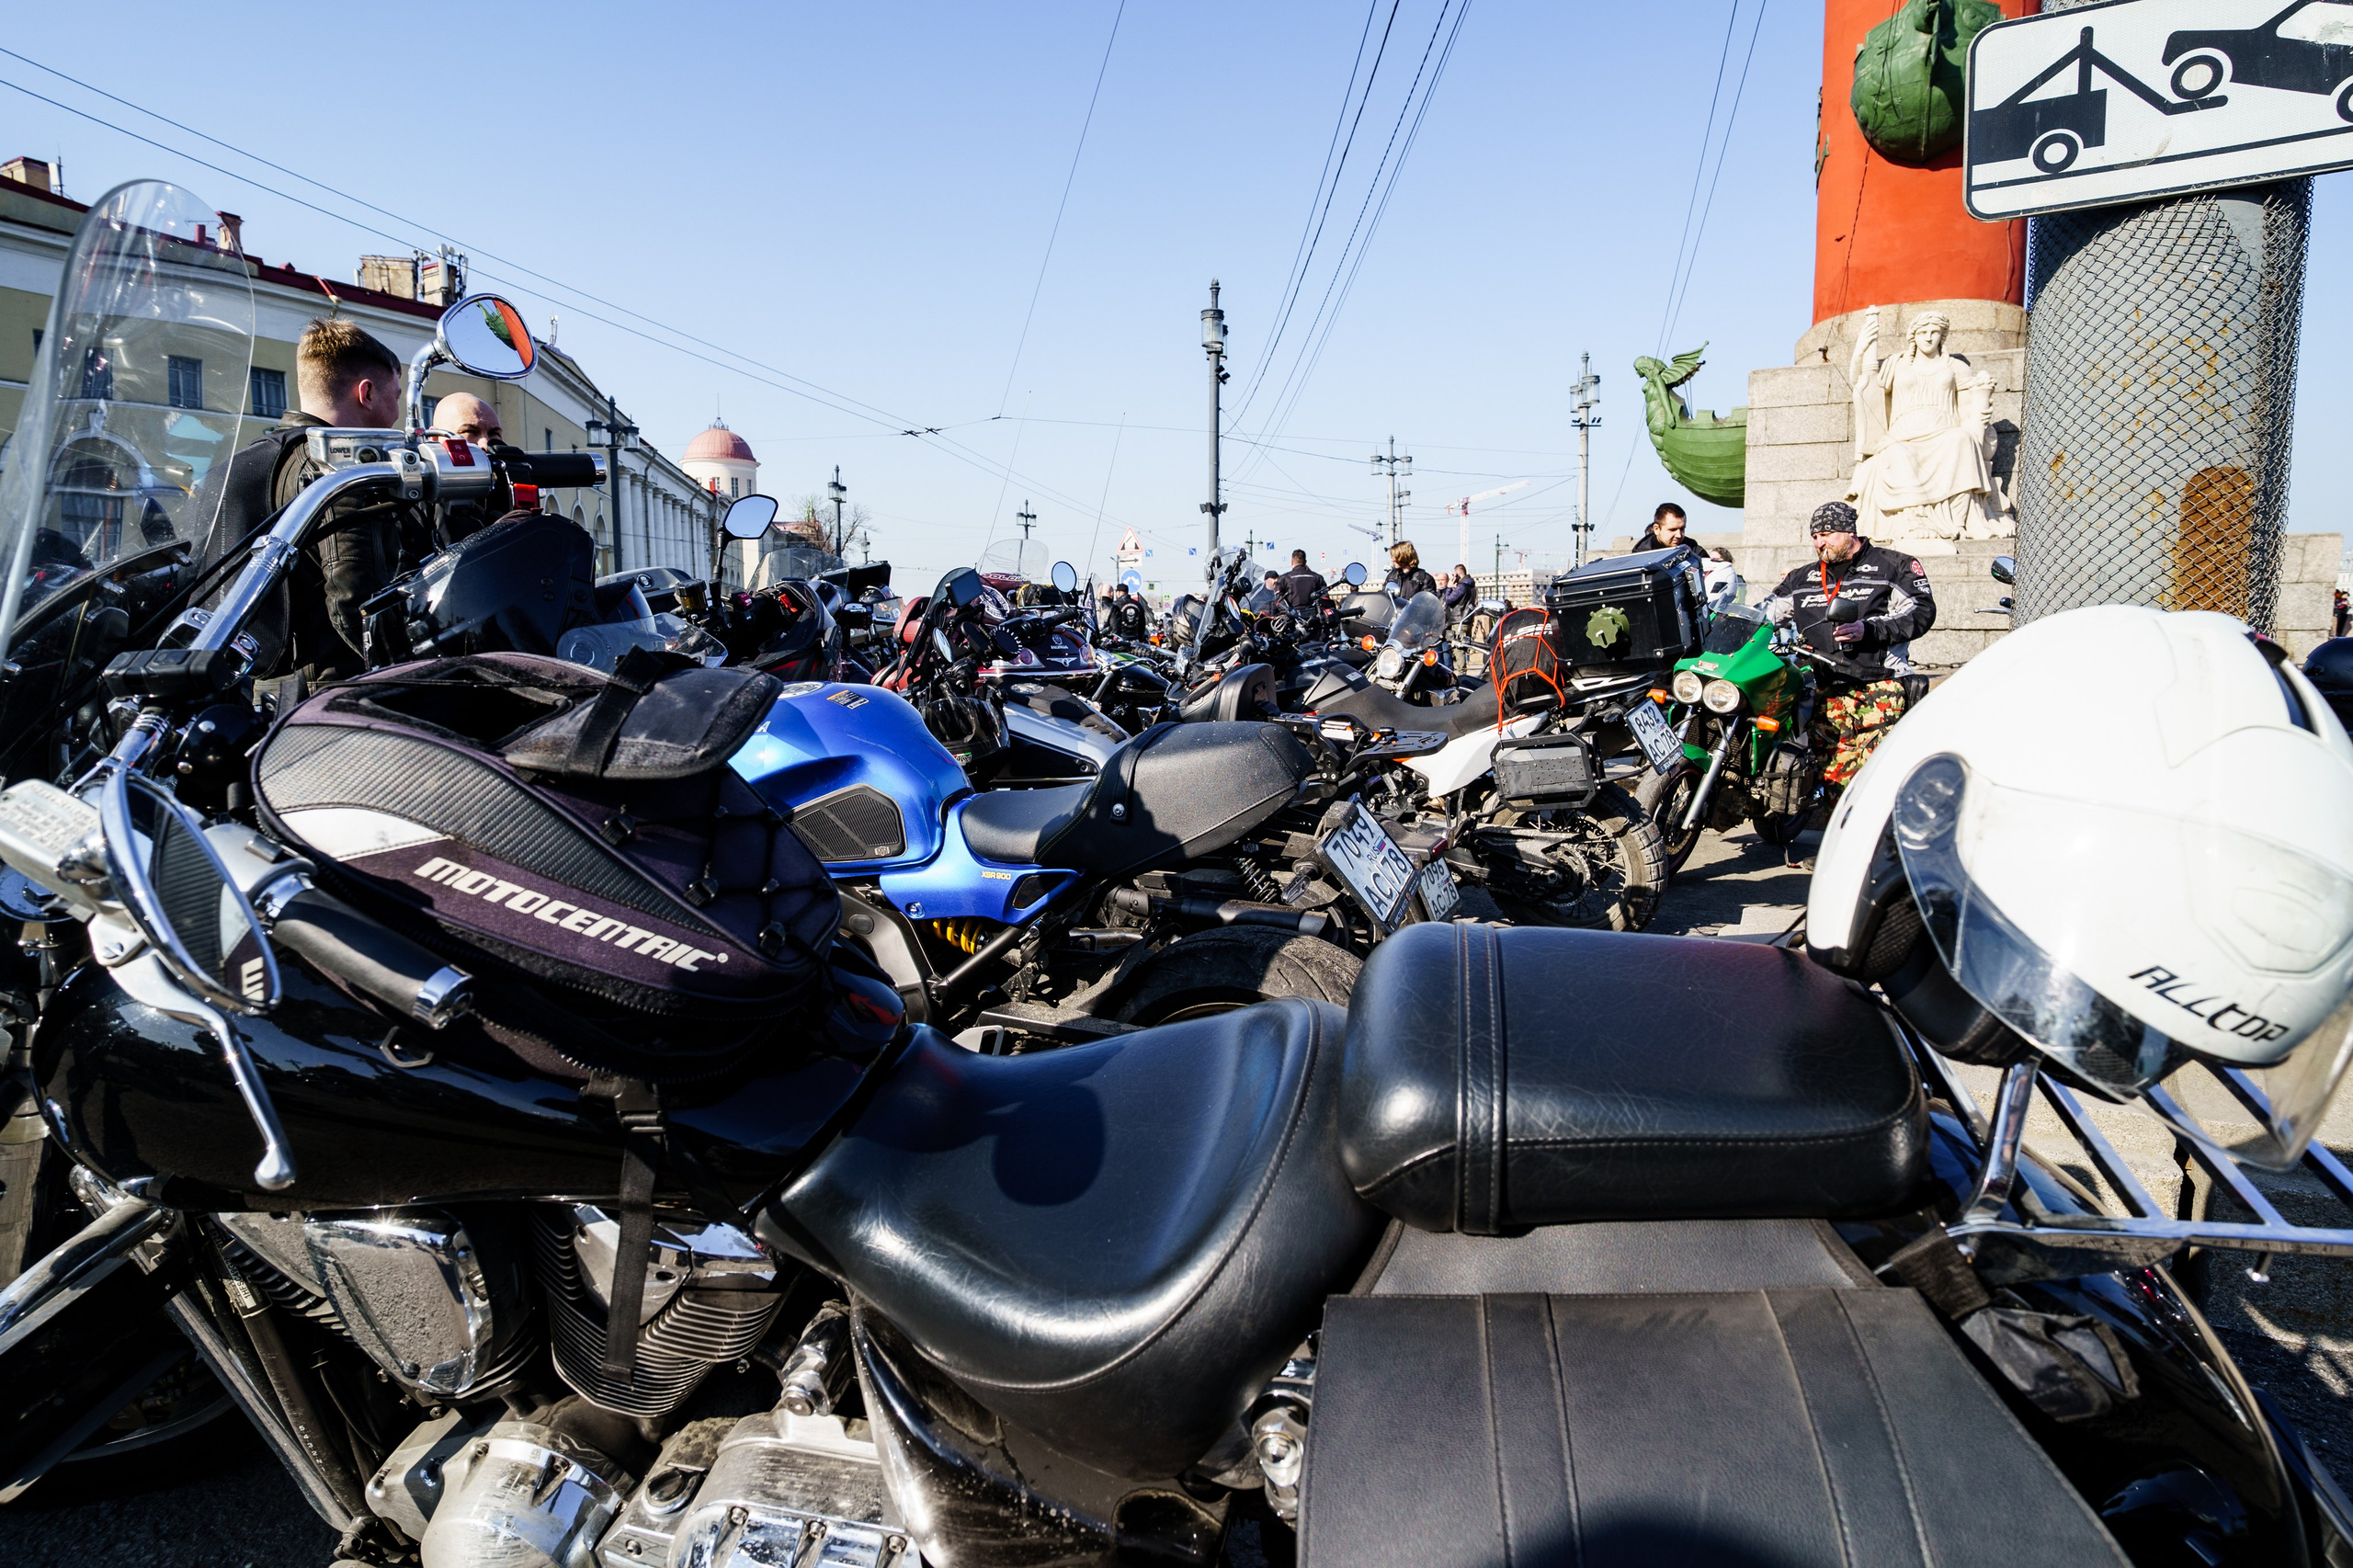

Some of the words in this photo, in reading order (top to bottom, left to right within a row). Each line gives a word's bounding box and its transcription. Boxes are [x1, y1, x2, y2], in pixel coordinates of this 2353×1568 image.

[1332, 816, 1374, 870] 7049
[1380, 847, 1408, 885] 78
[414, 857, 717, 972] MOTOCENTRIC
